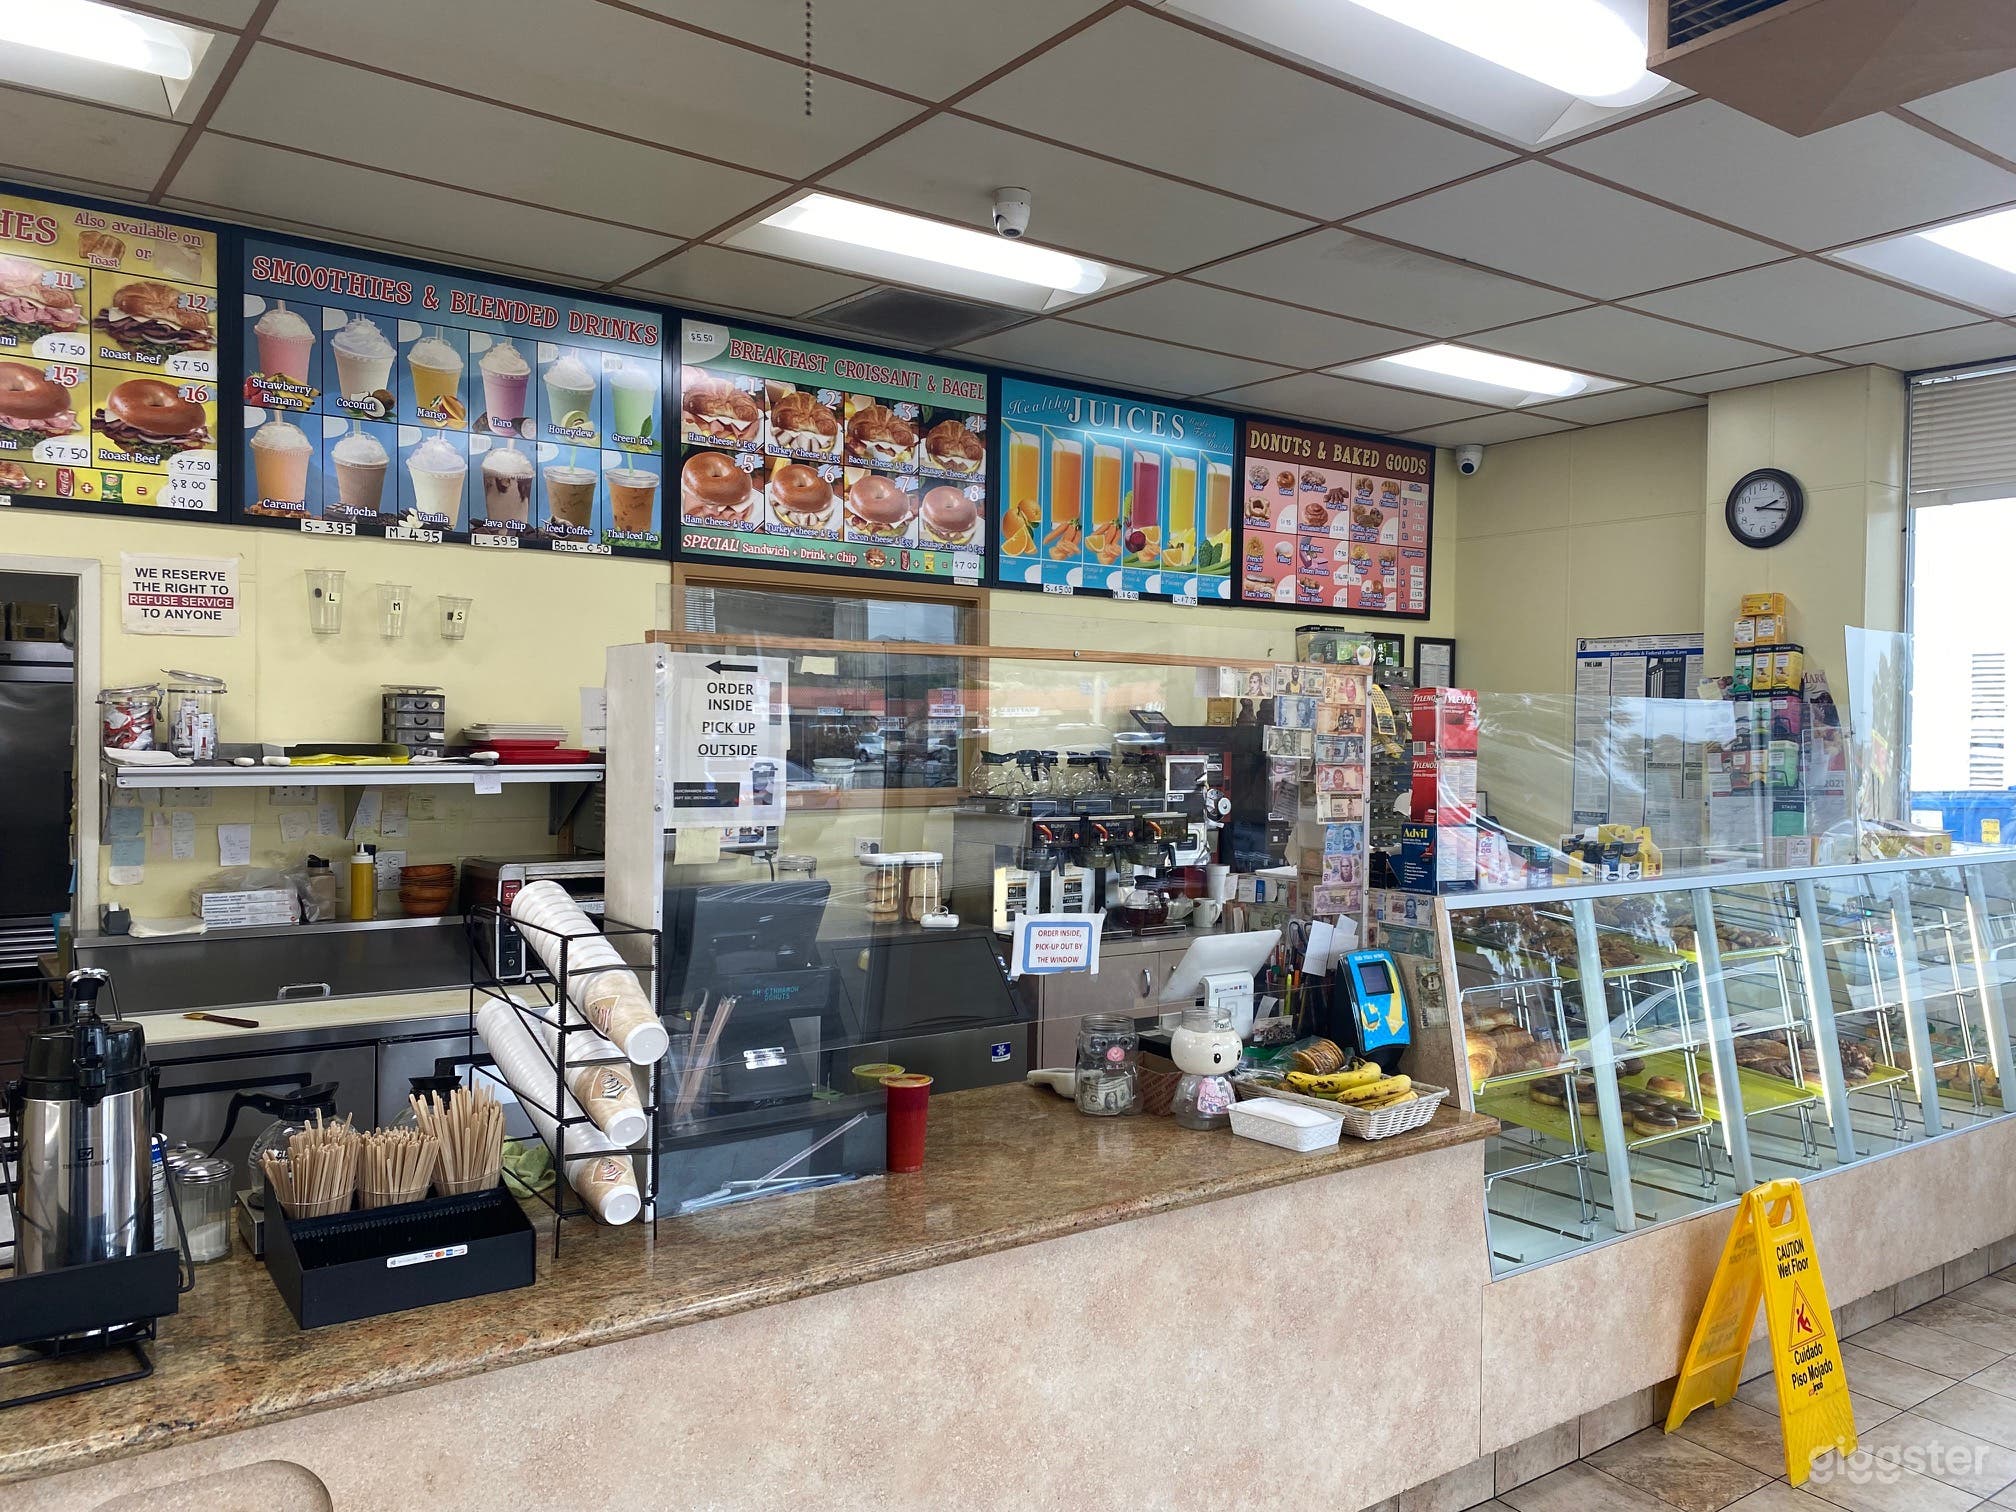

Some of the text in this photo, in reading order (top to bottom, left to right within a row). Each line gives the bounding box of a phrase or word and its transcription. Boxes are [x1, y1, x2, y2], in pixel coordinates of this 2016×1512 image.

[75, 211, 202, 246] Also available on
[88, 253, 119, 268] Toast
[136, 248, 151, 260] or
[55, 272, 74, 289] 11
[186, 293, 207, 313] 12
[253, 256, 658, 345] SMOOTHIES & BLENDED DRINKS
[100, 347, 161, 366] Roast Beef
[53, 366, 77, 386] 15
[730, 339, 985, 401] BREAKFAST CROISSANT & BAGEL
[185, 385, 208, 403] 16
[252, 379, 312, 396] Strawberry
[263, 394, 303, 407] Banana
[336, 398, 376, 411] Coconut
[824, 390, 836, 410] 2
[417, 408, 447, 421] Mango
[902, 403, 912, 421] 3
[1008, 394, 1184, 440] Healthy JUICES
[492, 417, 512, 428] Taro
[971, 416, 981, 433] 4
[549, 425, 594, 439] Honeydew
[612, 433, 653, 445] Green Tea
[688, 433, 757, 452] Ham Cheese Egg
[98, 449, 161, 465] Roast Beef
[768, 444, 794, 456] Turkey
[795, 448, 820, 459] Cheese
[1251, 430, 1427, 475] DONUTS & BAKED GOODS
[743, 455, 754, 474] 5
[848, 456, 869, 465] Bacon
[871, 459, 893, 469] Cheese
[824, 466, 835, 483] 6
[946, 470, 968, 479] Cheese
[901, 476, 910, 493] 7
[1750, 486, 1757, 495] 11
[1759, 483, 1768, 491] 12
[970, 485, 979, 501] 8
[1779, 491, 1784, 499] 2
[263, 499, 305, 511] Caramel
[1741, 496, 1751, 504] 10
[345, 506, 377, 518] Mocha
[418, 512, 449, 523] Vanilla
[483, 518, 526, 531] Java Chip
[685, 515, 754, 531] Ham Cheese Egg
[1750, 523, 1755, 532] 7
[1760, 525, 1766, 533] 6
[1770, 521, 1776, 529] 5
[545, 524, 593, 536] Iced Coffee
[607, 529, 659, 542] Thai Iced Tea
[767, 523, 839, 540] Turkey Cheese Egg
[848, 532, 869, 542] Bacon
[871, 535, 893, 545] Cheese
[683, 535, 857, 565] SPECIAL! Sandwich Drink Chip
[945, 541, 968, 551] Cheese
[135, 568, 225, 581] WE RESERVE
[133, 582, 229, 595] THE RIGHT TO
[129, 595, 232, 608] REFUSE SERVICE
[328, 592, 335, 602] L
[393, 602, 401, 611] M
[141, 608, 222, 620] TO ANYONE
[456, 612, 463, 621] S
[707, 682, 754, 696] ORDER
[708, 699, 753, 712] INSIDE
[702, 721, 755, 734] PICK UP
[698, 744, 758, 756] OUTSIDE
[1404, 827, 1428, 839] Advil
[1776, 1238, 1805, 1261] CAUTION
[1777, 1257, 1809, 1279] Wet Floor
[1794, 1342, 1823, 1366] Cuidado
[1791, 1359, 1833, 1389] Piso Mojado
